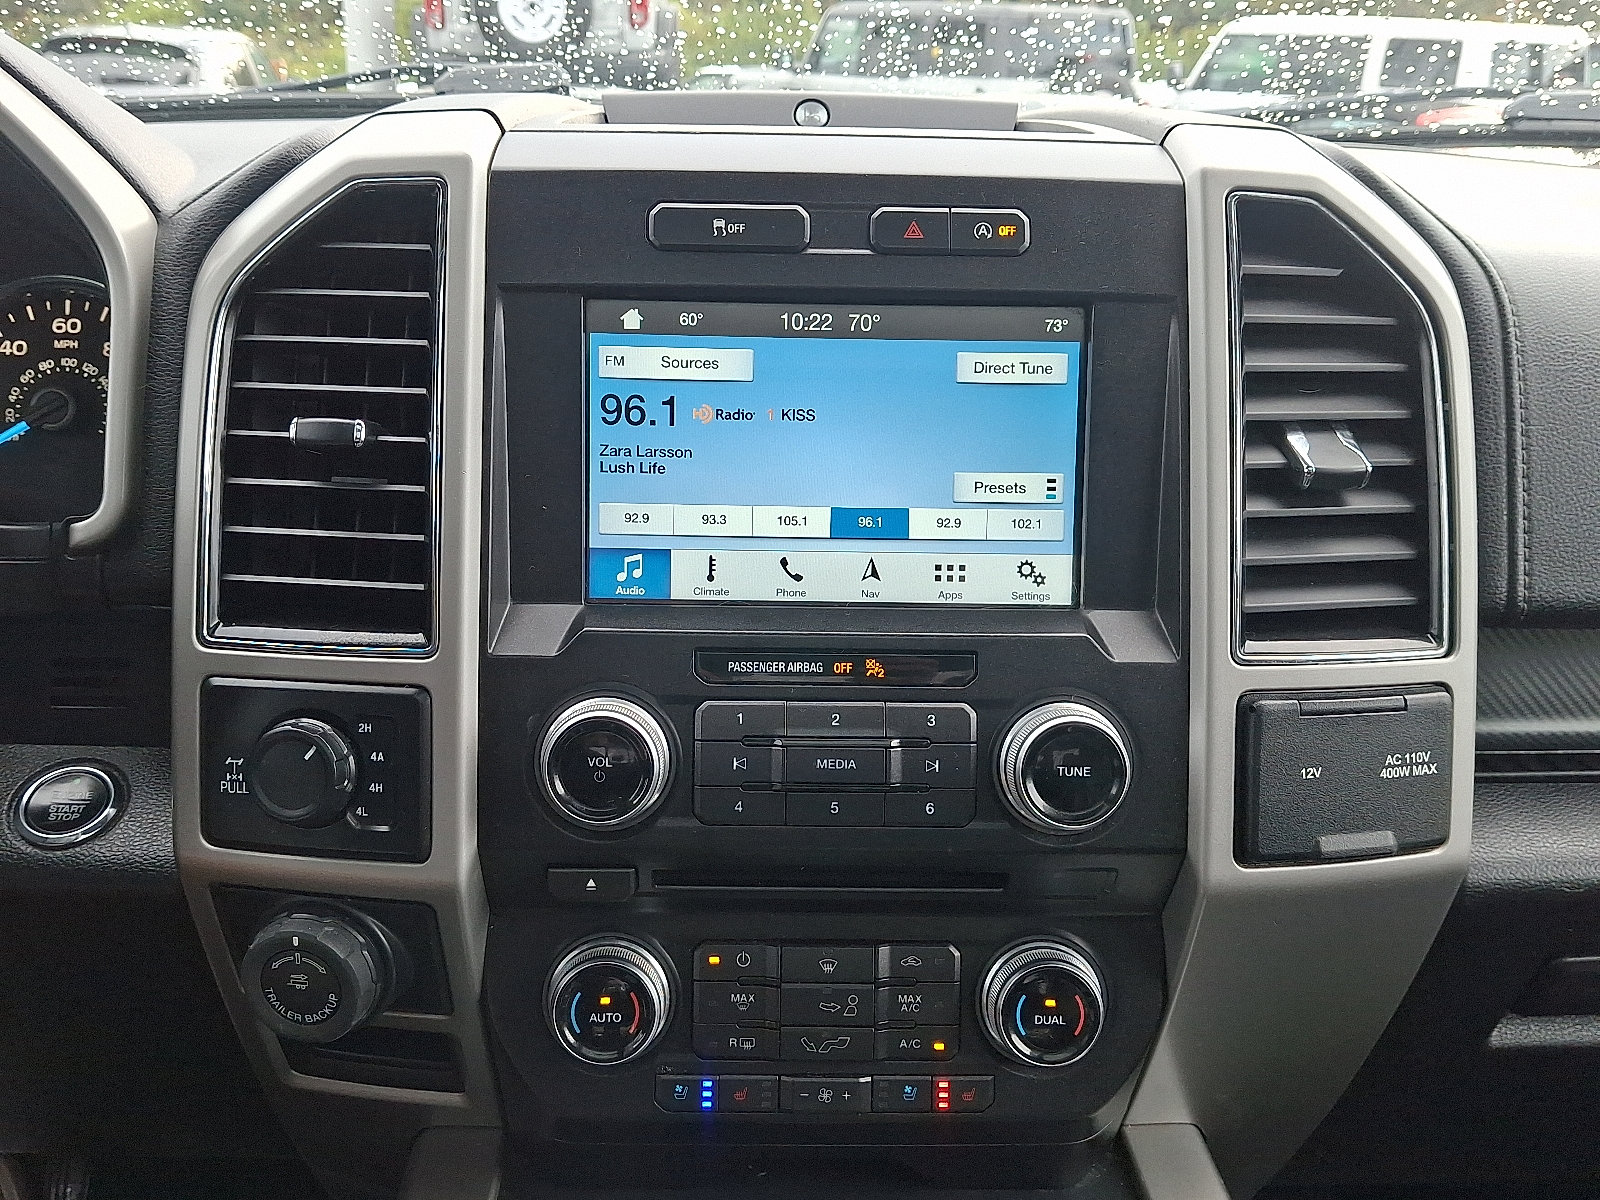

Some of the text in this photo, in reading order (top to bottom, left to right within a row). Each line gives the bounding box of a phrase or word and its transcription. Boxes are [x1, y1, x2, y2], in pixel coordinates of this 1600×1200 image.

[728, 222, 745, 234] OFF
[998, 224, 1017, 236] OFF
[679, 312, 704, 326] 60°
[780, 312, 833, 330] 10:22
[848, 314, 881, 332] 70°
[1044, 318, 1069, 332] 73°
[52, 318, 82, 334] 60
[0, 340, 28, 356] 40
[54, 339, 79, 349] MPH
[102, 341, 111, 357] 8
[605, 356, 625, 366] FM
[660, 356, 720, 370] Sources
[974, 361, 1053, 375] Direct Tune
[600, 394, 676, 427] 96.1
[715, 408, 754, 421] Radio
[767, 410, 774, 420] 1
[781, 408, 816, 422] KISS
[600, 444, 693, 459] Zara Larsson
[600, 461, 666, 474] Lush Life
[974, 481, 1026, 494] Presets
[624, 513, 650, 524] 92.9
[702, 514, 727, 525] 93.3
[777, 516, 808, 526] 105.1
[858, 516, 883, 528] 96.1
[936, 518, 962, 528] 92.9
[1011, 518, 1042, 530] 102.1
[615, 586, 646, 596] Audio
[693, 586, 730, 597] Climate
[776, 588, 807, 598] Phone
[861, 589, 880, 599] Nav
[938, 590, 963, 601] Apps
[1011, 591, 1050, 602] Settings
[728, 662, 853, 674] PASSENGER AIRBAG OFF
[736, 712, 744, 725] 1
[831, 713, 840, 726] 2
[926, 714, 936, 726] 3
[358, 723, 372, 733] 2H
[370, 752, 384, 762] 4A
[587, 756, 613, 768] VOL
[1385, 750, 1431, 766] AC 110V
[816, 758, 857, 770] MEDIA
[1057, 766, 1092, 777] TUNE
[1300, 766, 1322, 780] 12V
[1380, 763, 1438, 779] 400W MAX
[220, 780, 250, 794] PULL
[368, 782, 383, 793] 4H
[48, 804, 86, 813] START
[356, 806, 368, 816] 4L
[734, 801, 743, 812] 4
[830, 802, 840, 814] 5
[926, 802, 935, 814] 6
[48, 812, 80, 821] STOP
[730, 993, 755, 1002] MAX
[898, 994, 922, 1004] MAX
[264, 986, 339, 1024] TRAILER BACKUP
[900, 1003, 920, 1012] A/C
[589, 1012, 622, 1022] AUTO
[1034, 1015, 1066, 1025] DUAL
[729, 1038, 737, 1048] R
[899, 1038, 921, 1049] A/C
